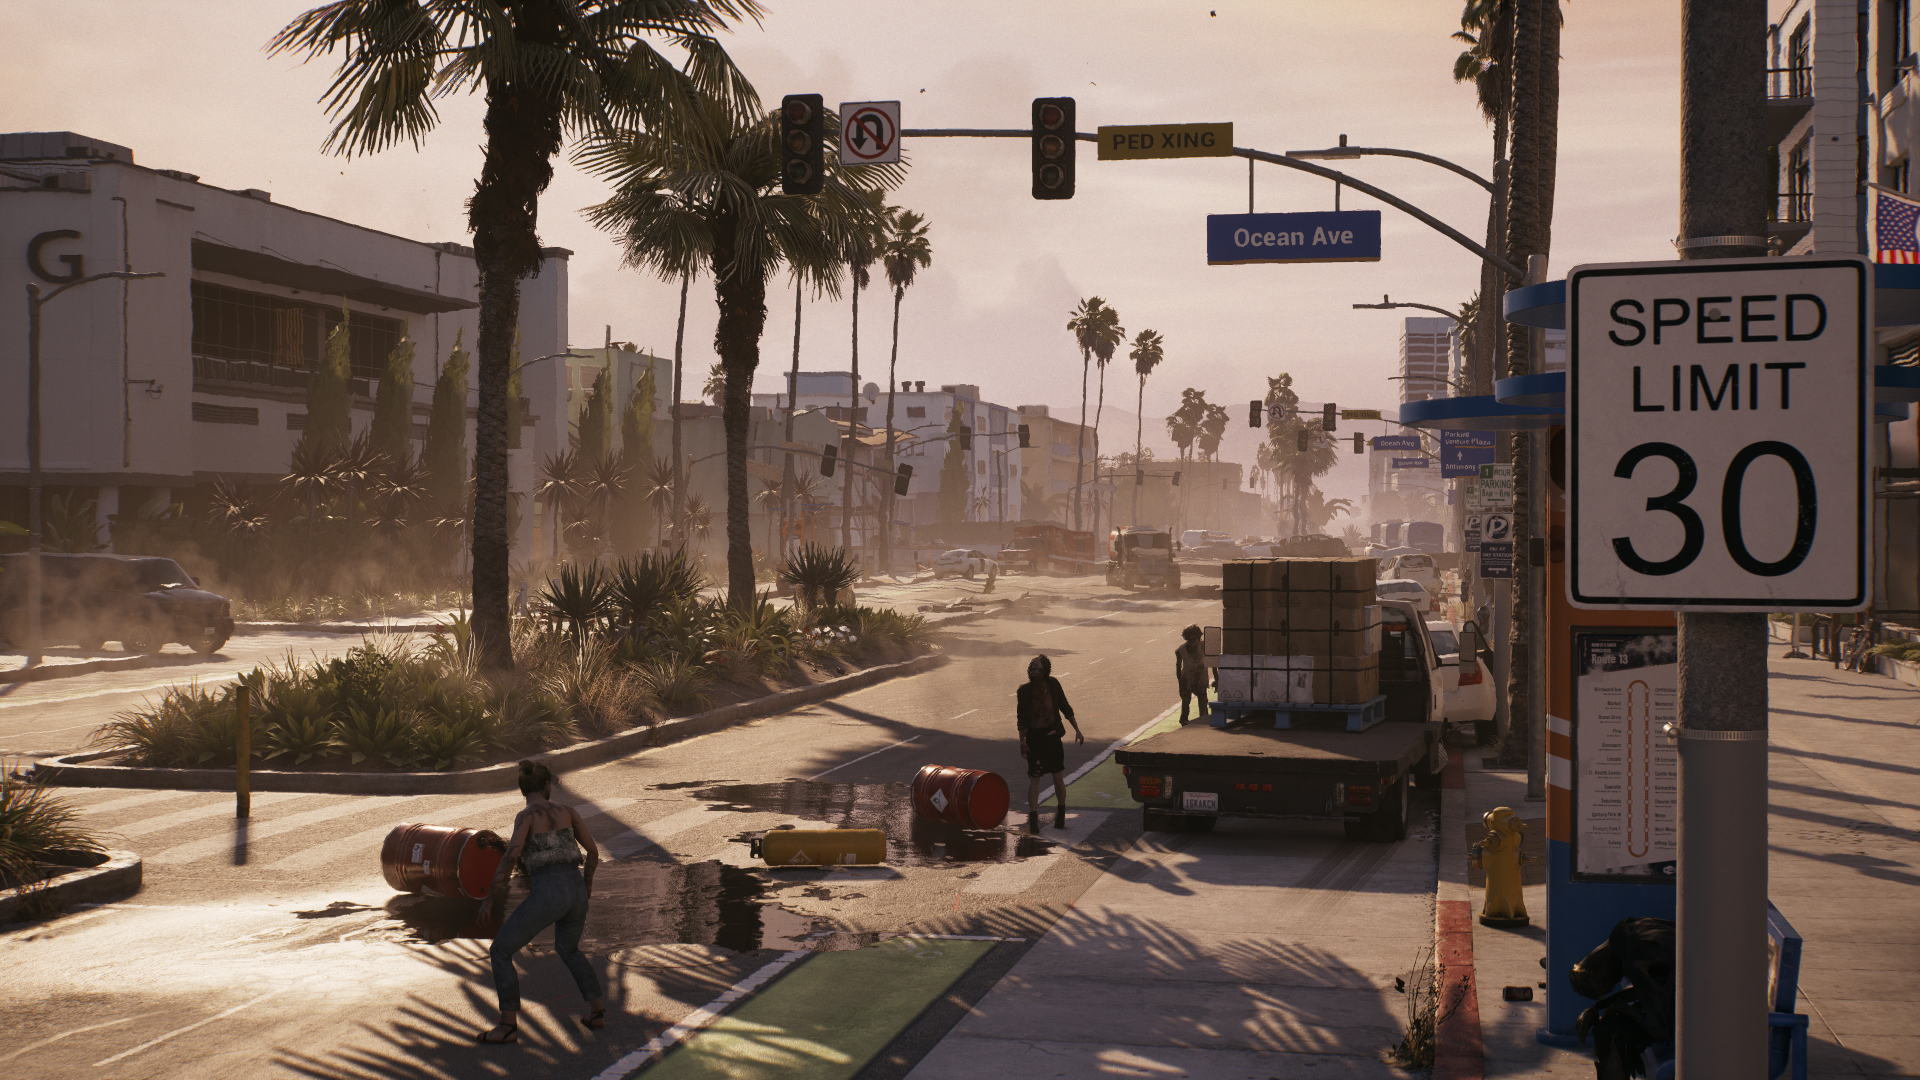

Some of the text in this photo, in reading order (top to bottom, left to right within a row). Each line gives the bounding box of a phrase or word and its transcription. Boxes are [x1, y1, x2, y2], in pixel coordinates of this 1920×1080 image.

[1113, 132, 1215, 150] PED XING
[1234, 226, 1353, 248] Ocean Ave
[27, 229, 84, 284] G
[1609, 293, 1828, 346] SPEED
[1633, 361, 1807, 412] LIMIT
[1445, 431, 1470, 439] Parking
[1471, 438, 1491, 446] Plaza
[1401, 440, 1415, 448] Ave
[1484, 467, 1512, 477] 1 HOUR
[1481, 479, 1512, 489] PARKING
[1611, 440, 1818, 577] 30
[1591, 653, 1629, 665] Route 13
